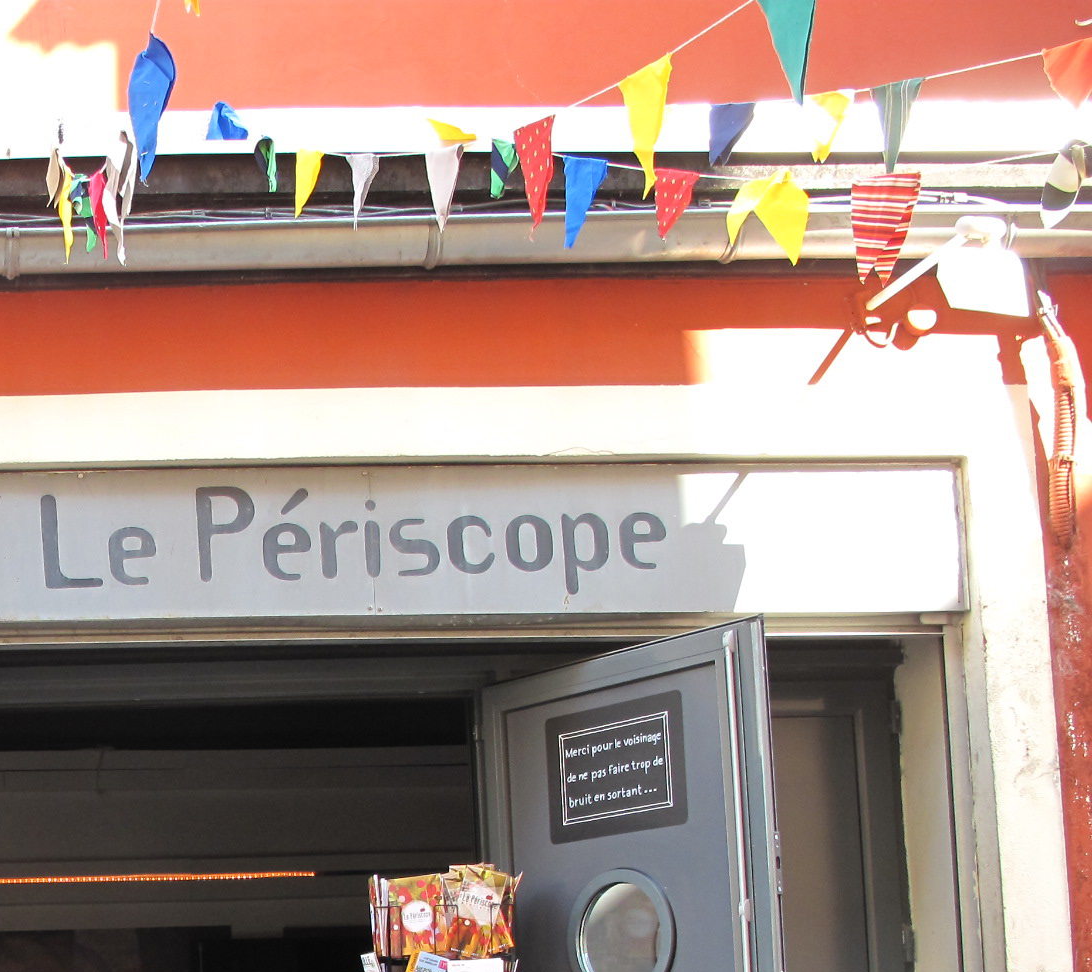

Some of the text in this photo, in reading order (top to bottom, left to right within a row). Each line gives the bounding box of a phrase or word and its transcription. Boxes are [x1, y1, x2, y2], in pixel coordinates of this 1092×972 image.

[40, 485, 667, 595] Le Périscope
[565, 731, 662, 759] Merci pour le voisinage
[567, 756, 664, 783] de ne pas faire trop de
[568, 795, 592, 808] bruit
[594, 793, 605, 802] en
